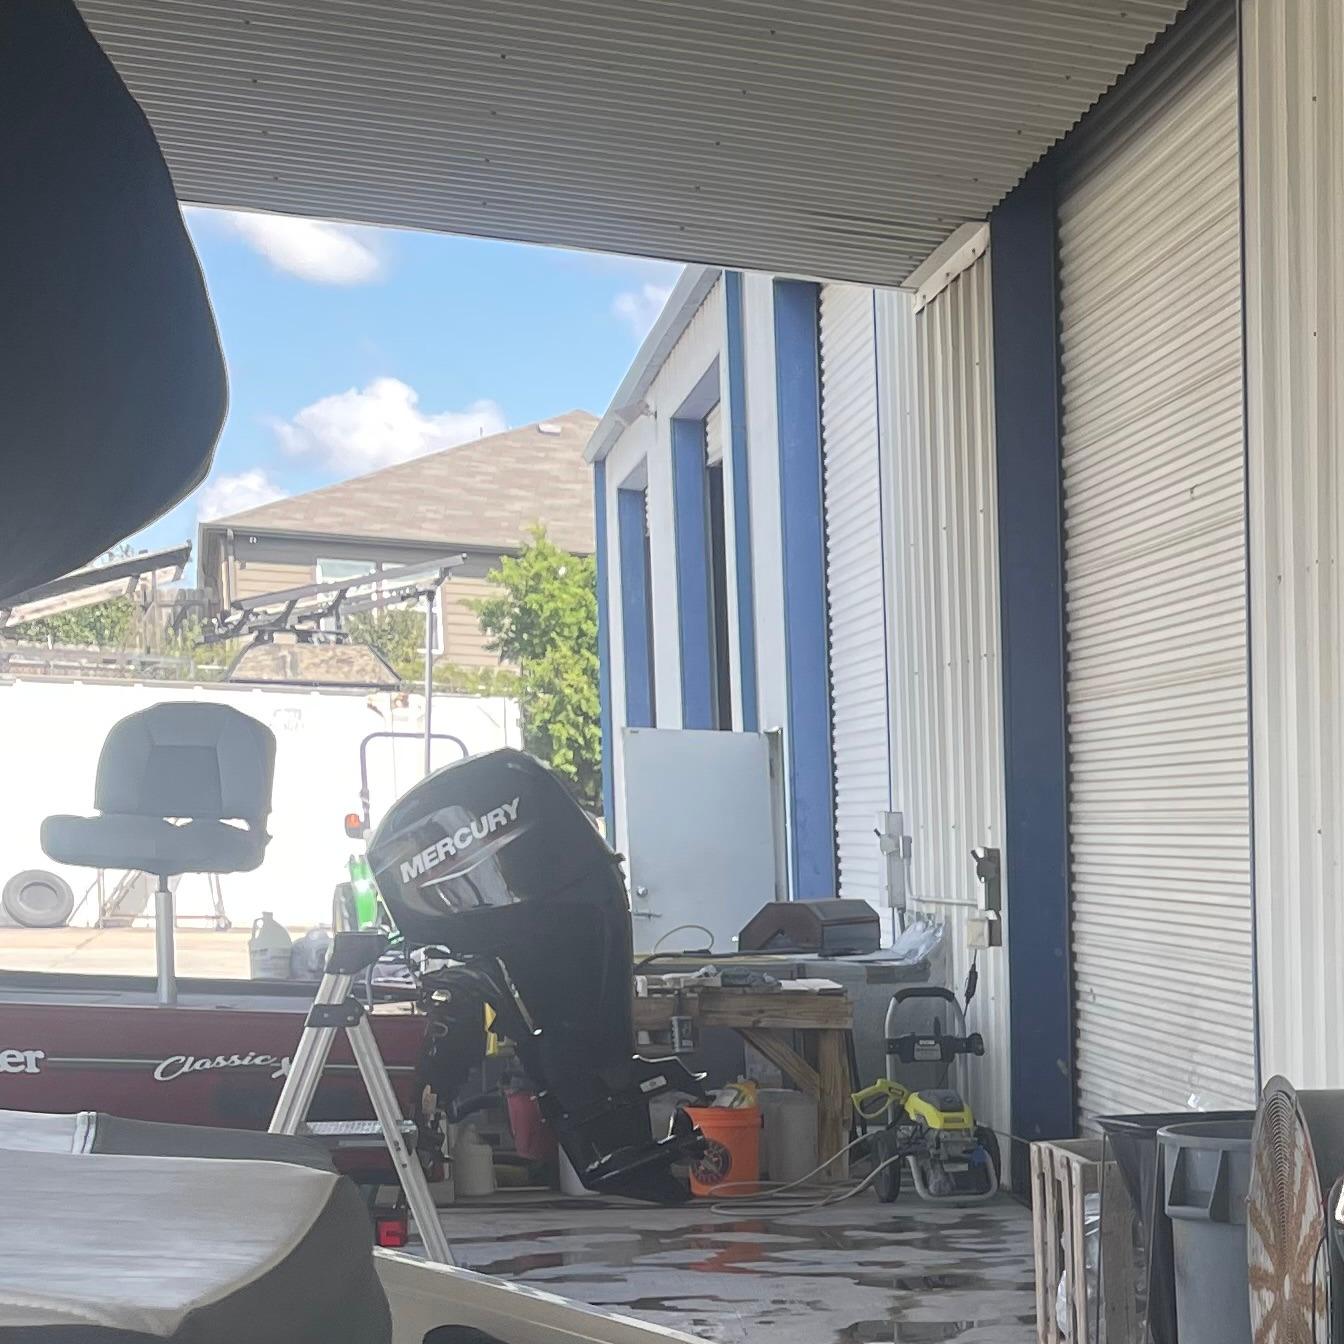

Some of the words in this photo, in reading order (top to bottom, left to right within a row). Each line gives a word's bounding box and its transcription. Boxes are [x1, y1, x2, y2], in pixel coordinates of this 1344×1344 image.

[400, 796, 520, 884] MERCURY
[0, 1049, 46, 1073] er
[153, 1051, 278, 1081] Classic
